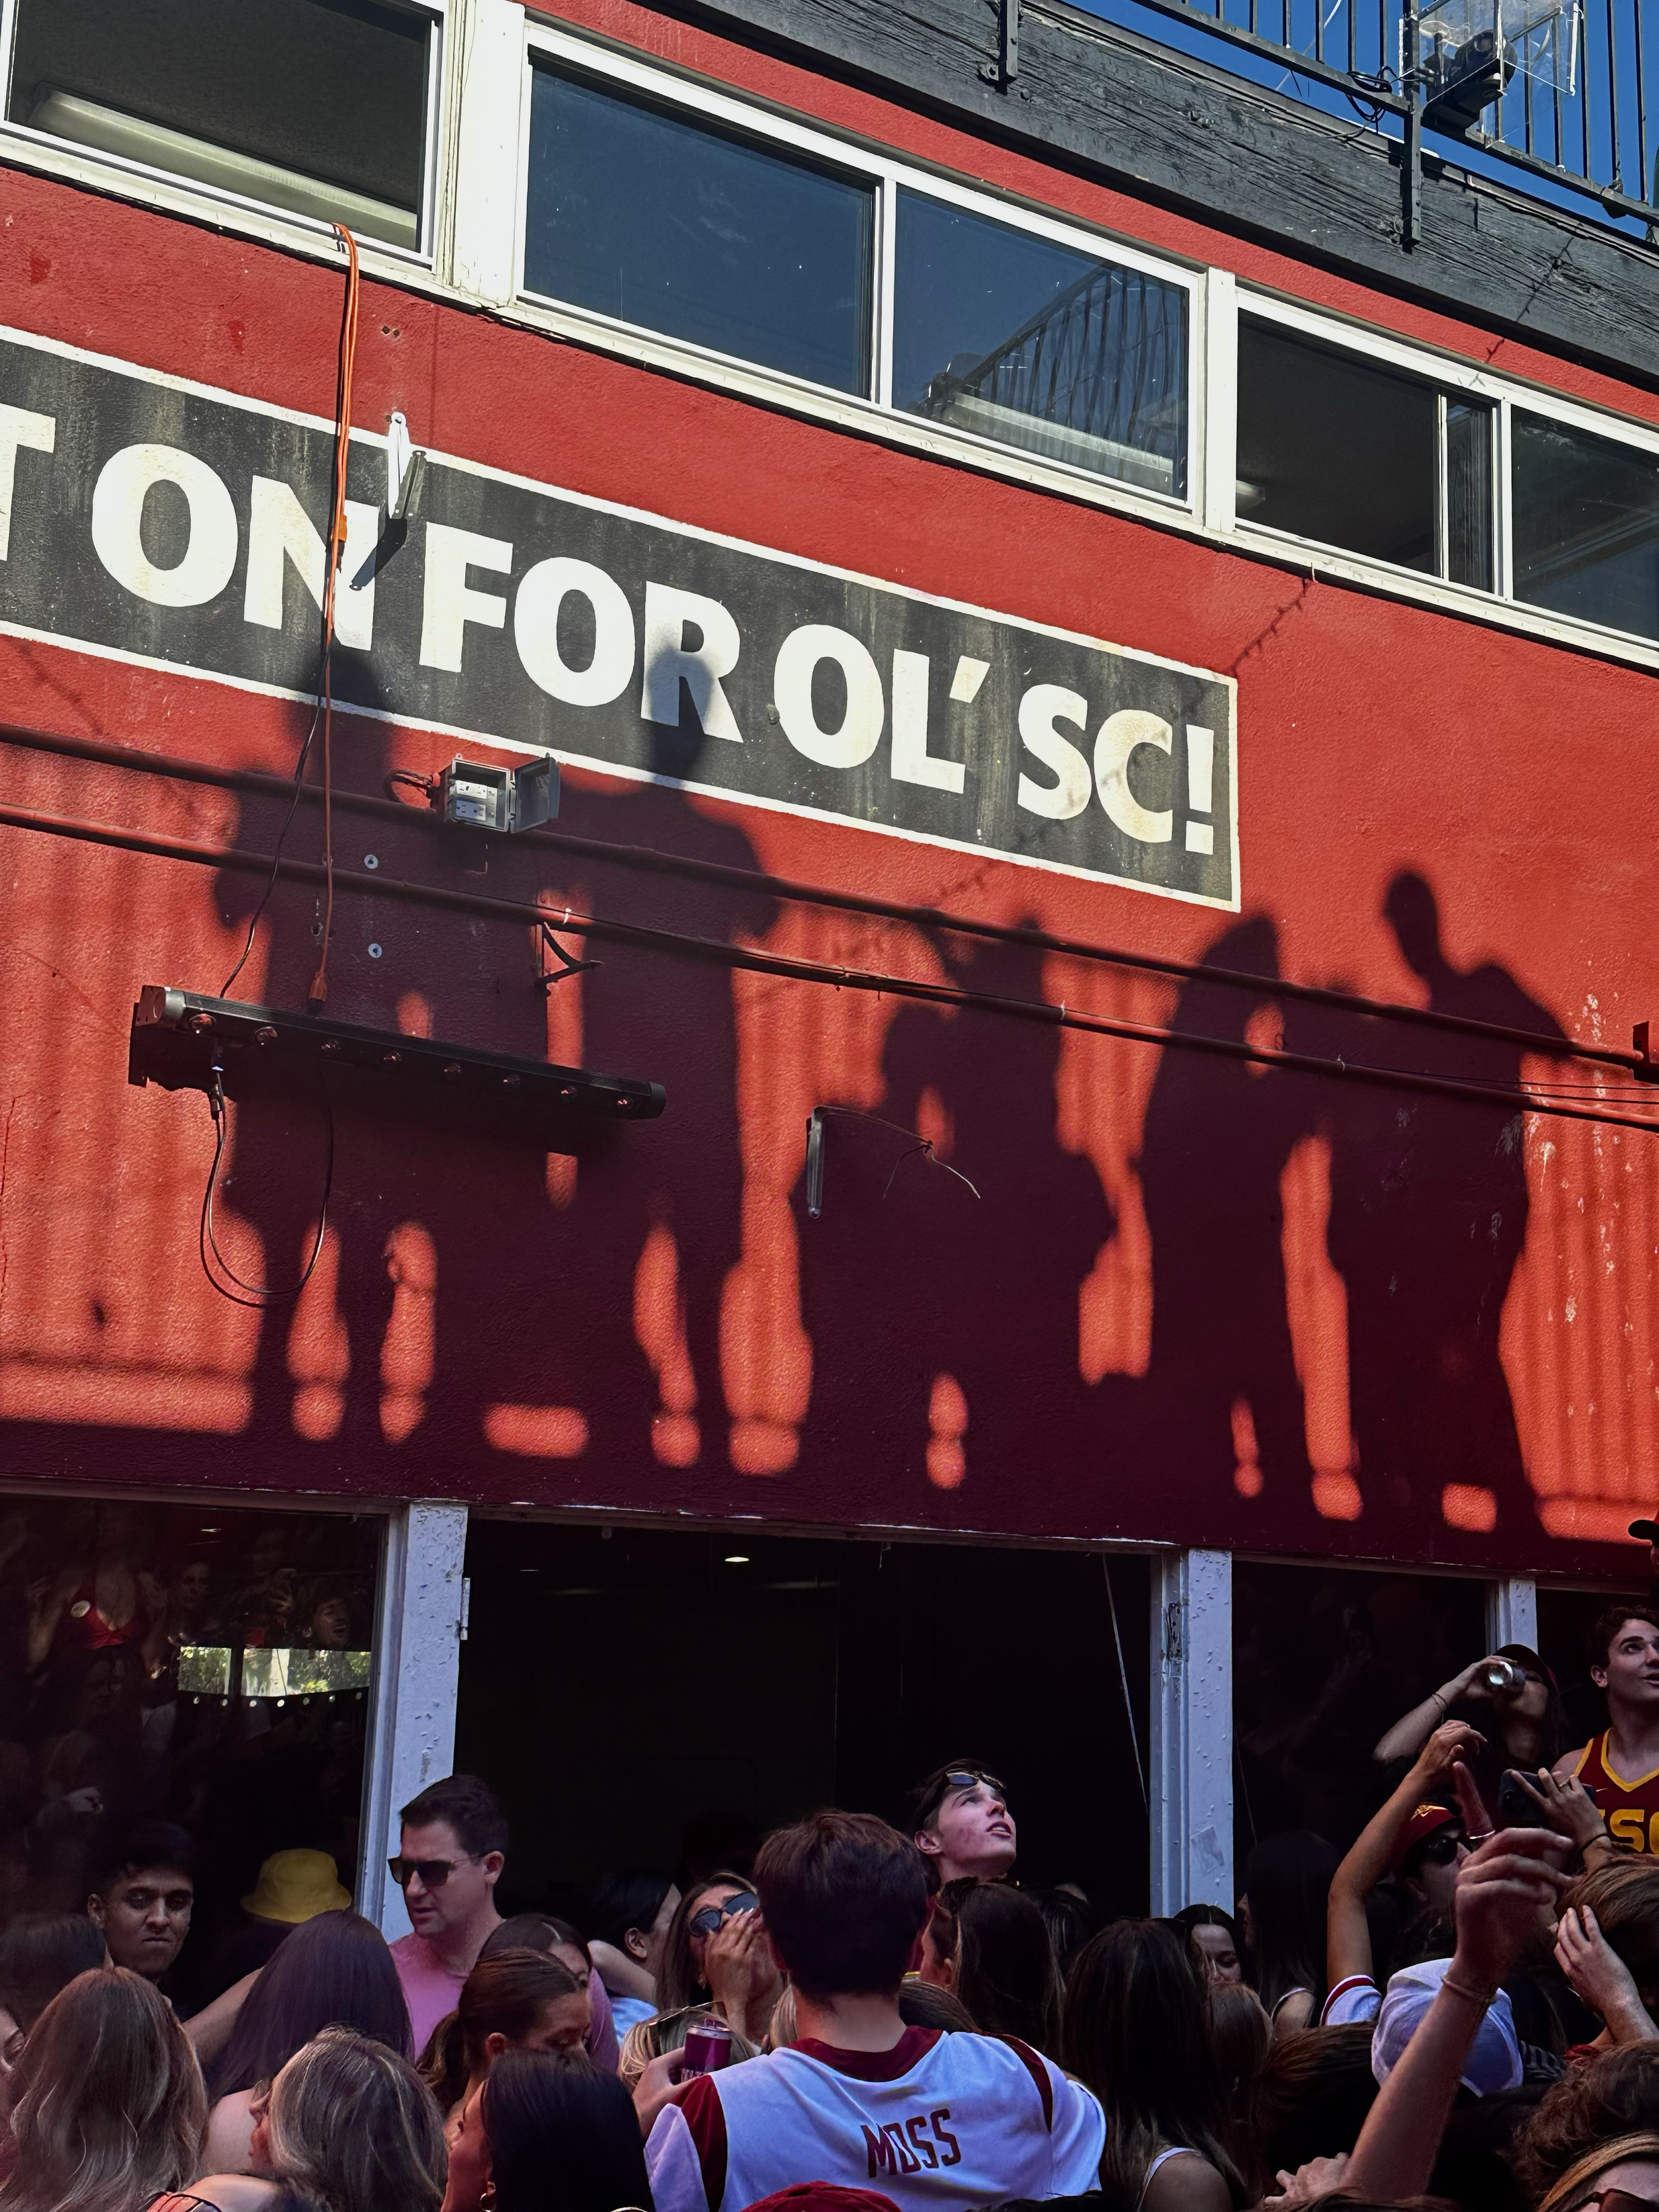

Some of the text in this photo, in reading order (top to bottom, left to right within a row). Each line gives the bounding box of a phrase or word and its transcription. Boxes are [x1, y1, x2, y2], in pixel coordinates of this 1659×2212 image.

[92, 443, 380, 651] ON
[419, 521, 744, 743] FOR
[1017, 683, 1214, 855] SC!
[860, 2108, 962, 2178] MOSS
